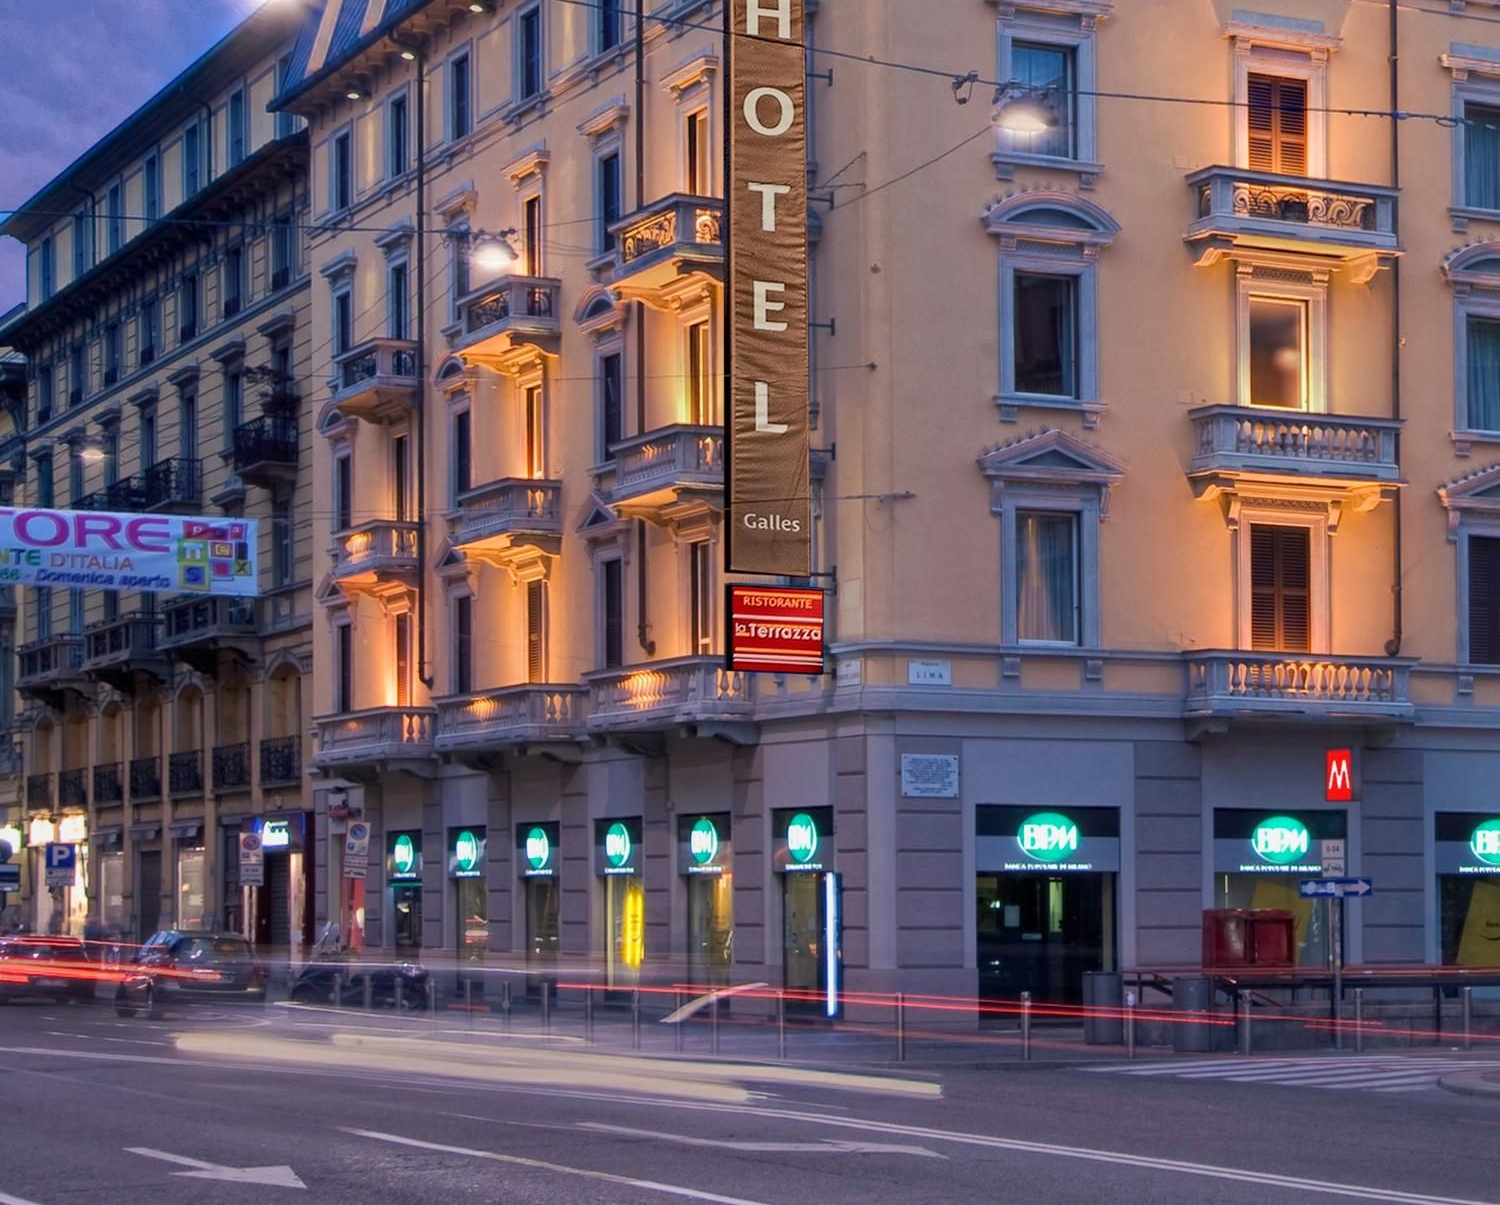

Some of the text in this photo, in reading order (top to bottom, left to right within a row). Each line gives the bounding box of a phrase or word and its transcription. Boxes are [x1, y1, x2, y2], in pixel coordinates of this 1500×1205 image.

[0, 509, 171, 554] ORE
[743, 513, 801, 533] Galles
[50, 552, 135, 572] D'ITALIA
[35, 568, 115, 586] Domenica
[118, 573, 171, 590] aperto
[743, 595, 813, 610] RISTORANTE
[735, 622, 822, 642] la Terrazza
[1328, 759, 1350, 790] M
[1023, 823, 1078, 851] BPM
[1256, 827, 1308, 854] BPM
[52, 846, 71, 866] P
